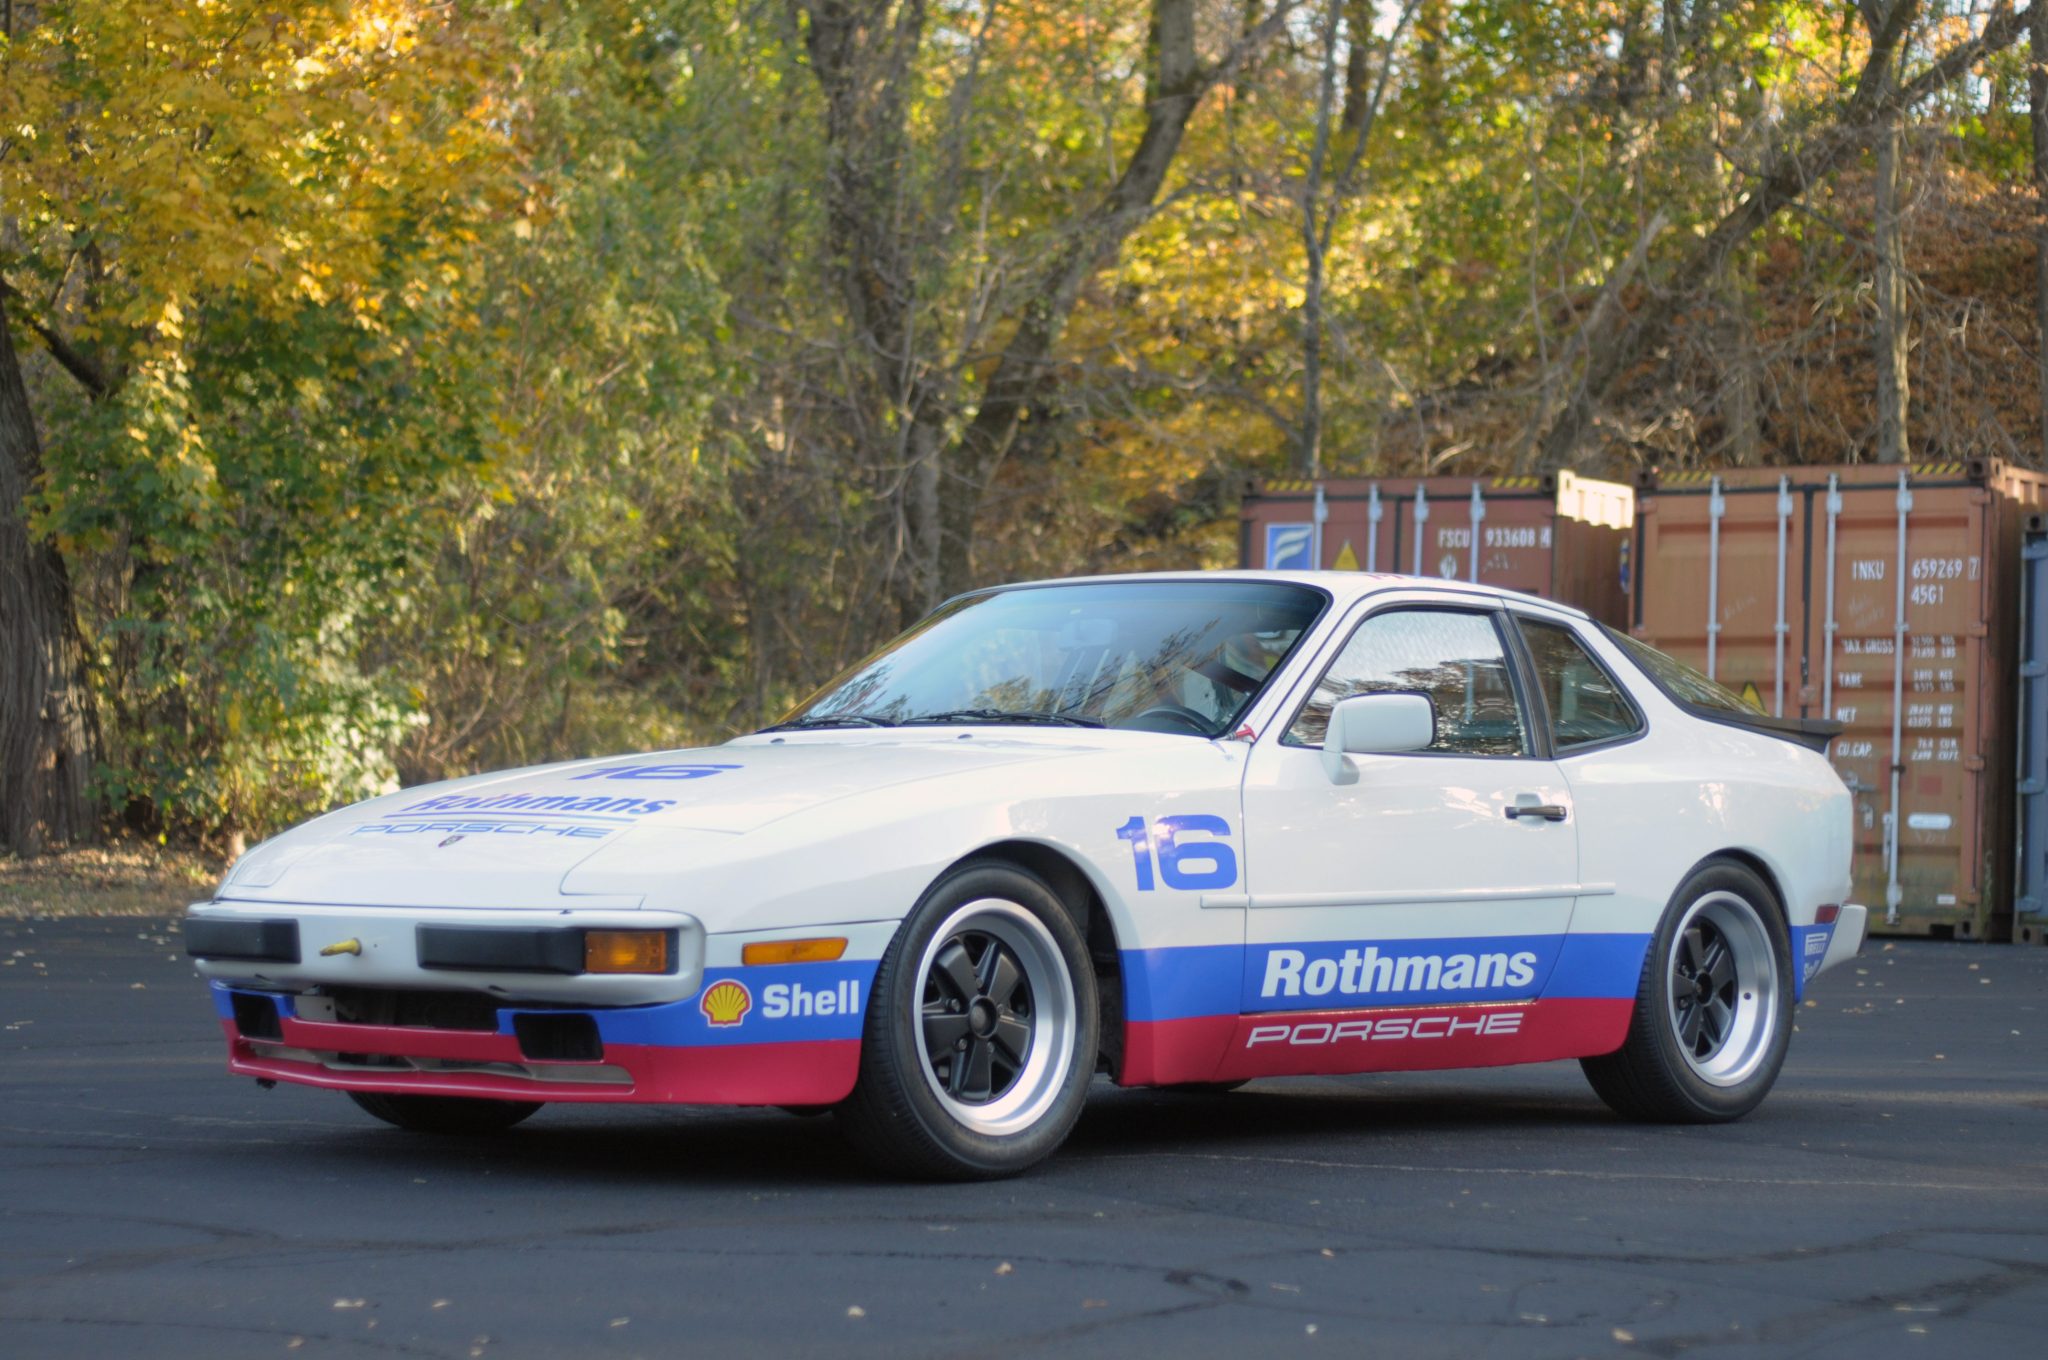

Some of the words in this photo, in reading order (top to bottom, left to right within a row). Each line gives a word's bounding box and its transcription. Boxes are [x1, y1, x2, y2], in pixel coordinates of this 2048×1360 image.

[1439, 527, 1471, 548] FSCU
[1485, 527, 1536, 548] 933608
[1541, 527, 1553, 548] 4
[1852, 560, 1885, 580] INKU
[1911, 558, 1963, 579] 659269
[1968, 556, 1980, 580] 7
[1911, 584, 1944, 604] 45G1
[568, 764, 744, 780] 16
[400, 792, 677, 815] Rothmans
[350, 823, 615, 838] PORSCHE
[1116, 814, 1238, 891] 16
[1261, 947, 1537, 998] Rothmans
[762, 979, 860, 1019] Shell
[1246, 1013, 1524, 1049] PORSCHE
